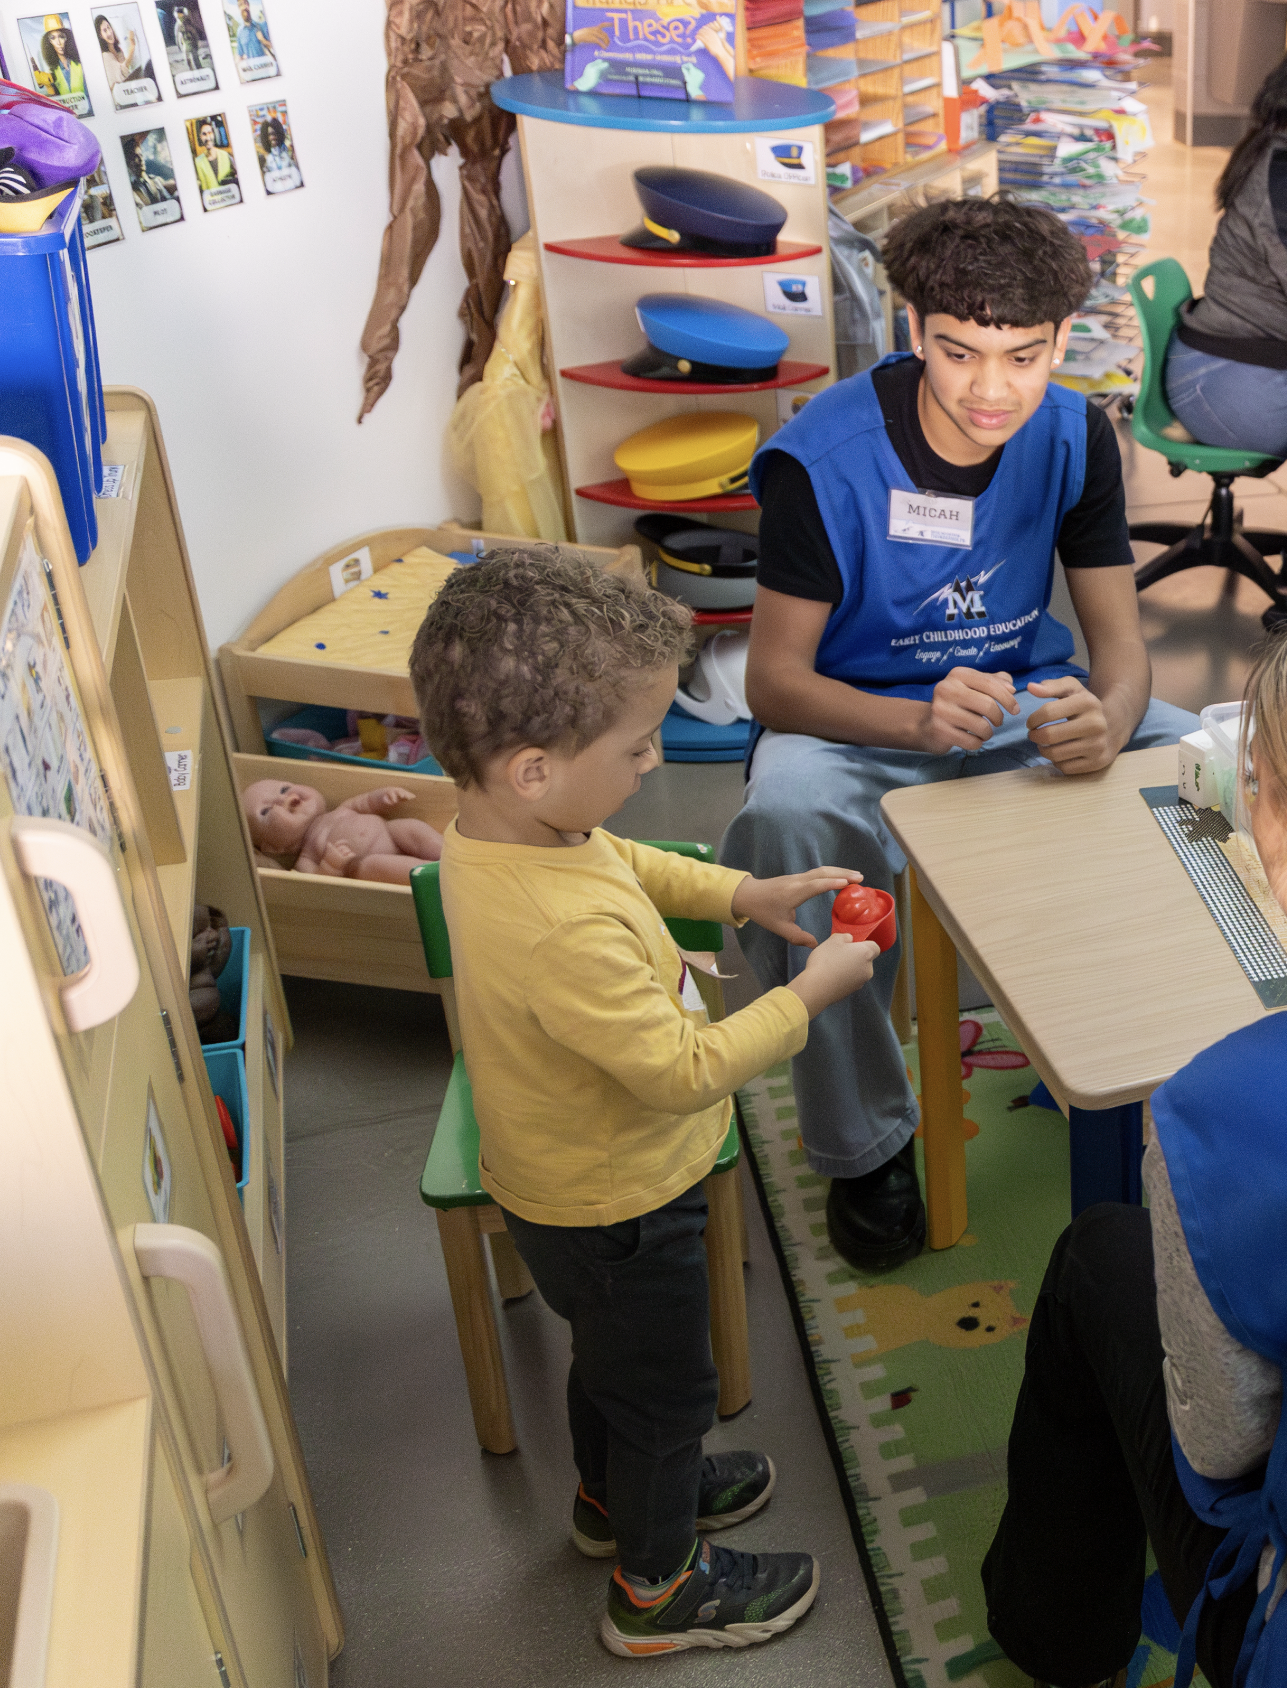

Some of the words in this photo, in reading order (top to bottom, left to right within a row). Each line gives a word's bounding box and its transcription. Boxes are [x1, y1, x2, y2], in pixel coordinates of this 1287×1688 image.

[605, 10, 697, 43] These?
[123, 85, 148, 96] TEACHER
[907, 503, 960, 521] MICAH
[890, 634, 920, 647] EARLY
[922, 625, 988, 643] CHILDHOOD
[989, 607, 1040, 636] EDUCATION
[914, 648, 942, 663] Engage
[954, 645, 979, 657] Create
